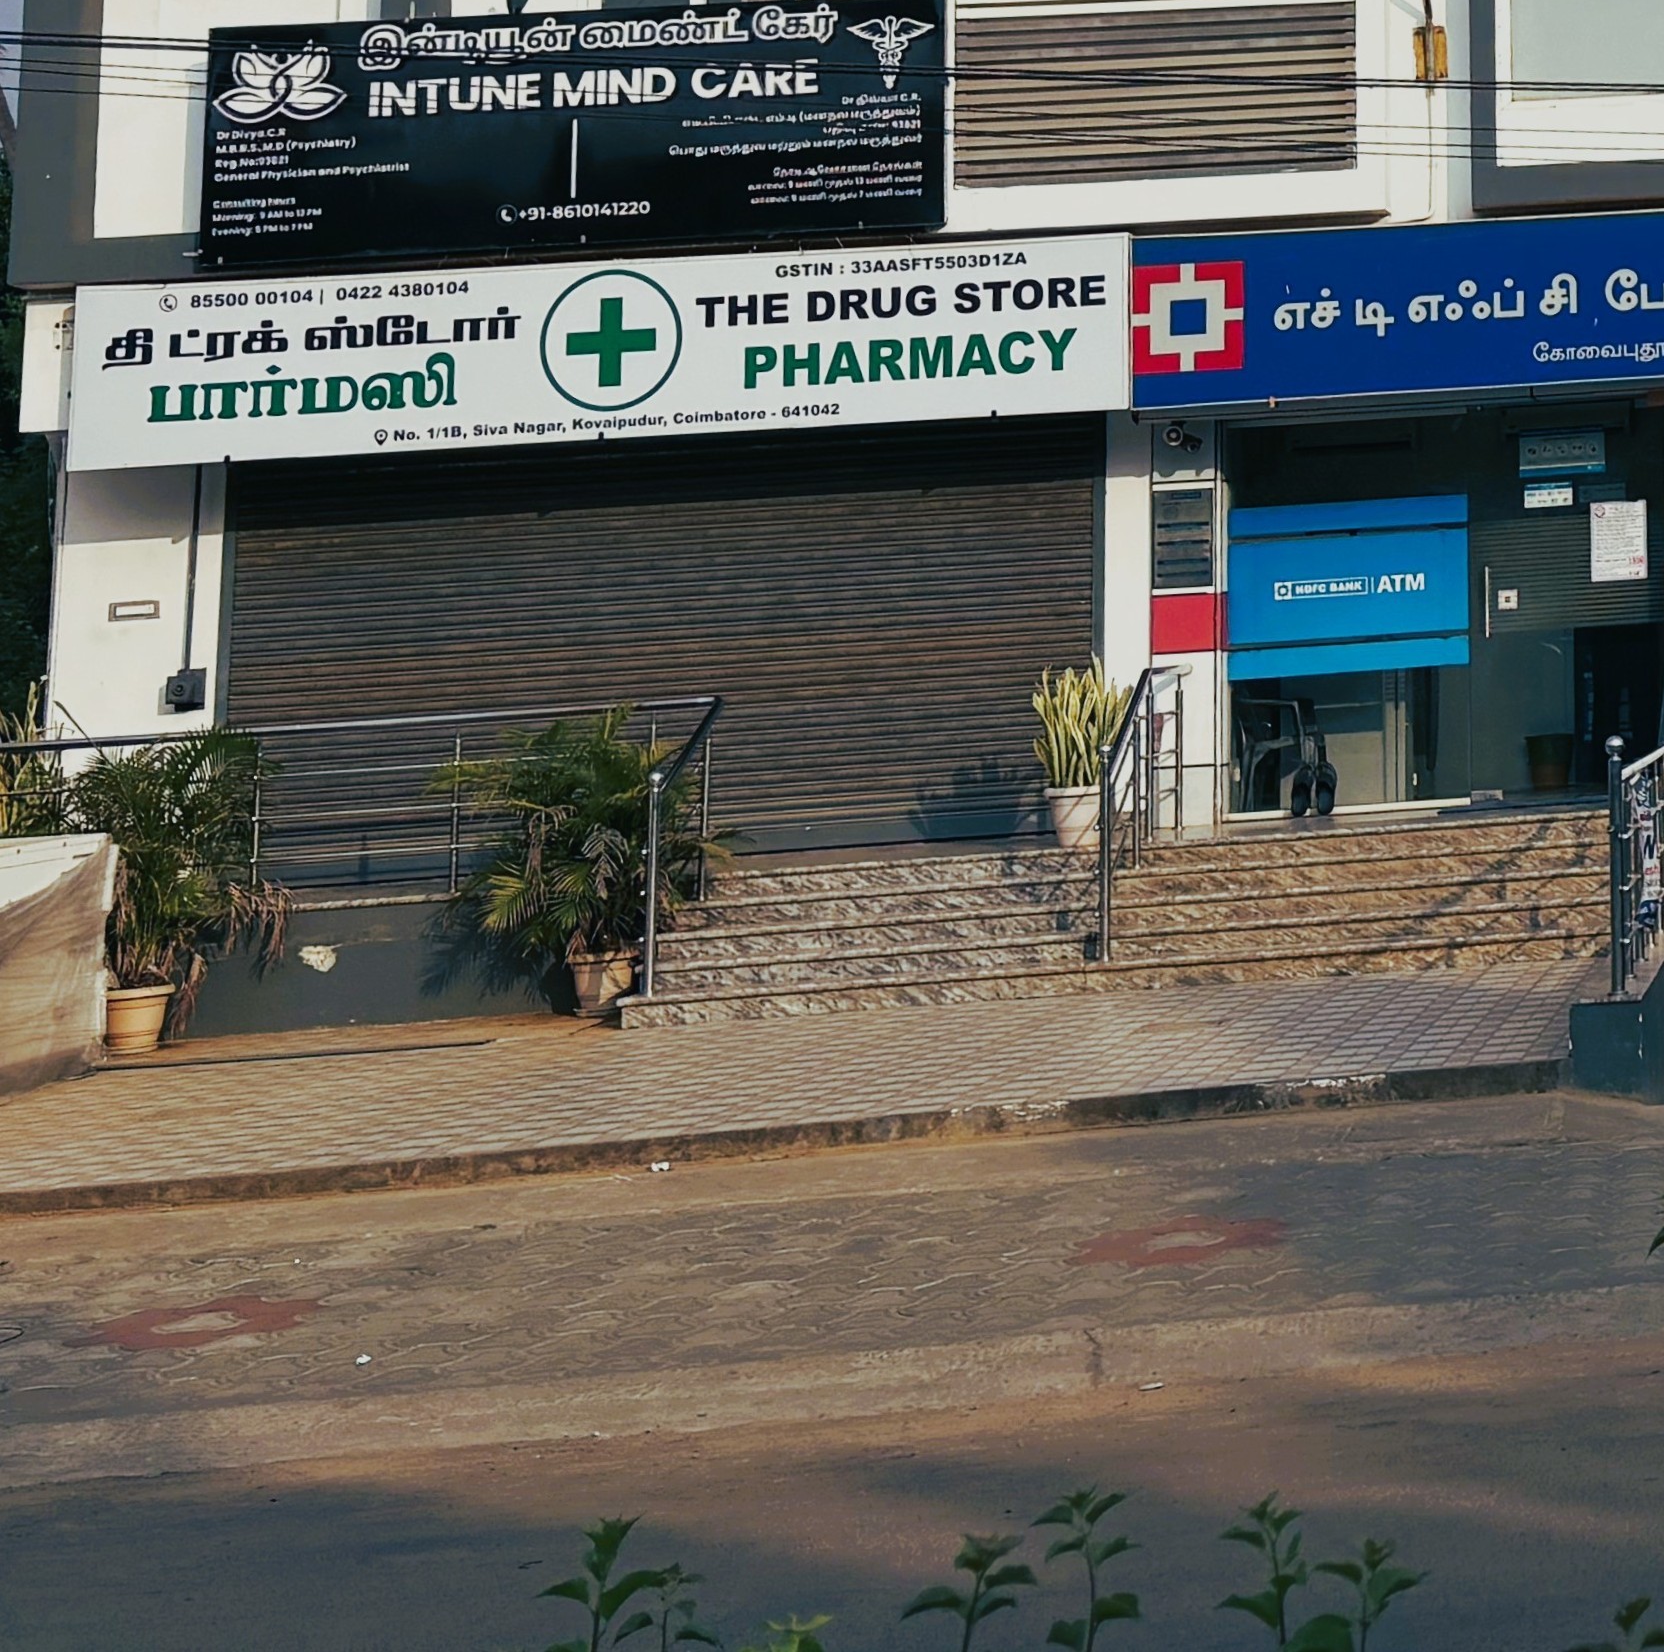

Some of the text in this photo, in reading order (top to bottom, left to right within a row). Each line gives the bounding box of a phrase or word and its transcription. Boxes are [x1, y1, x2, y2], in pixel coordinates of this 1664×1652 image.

[580, 8, 750, 50] மைண்ட்
[752, 3, 839, 45] கேர்
[367, 58, 820, 117] INTUNE MIND CARE
[216, 130, 230, 141] Dr
[214, 162, 410, 183] General Physician and Psychiatrist
[518, 200, 651, 222] +91-8610141220
[774, 260, 834, 279] GSTIN
[189, 279, 471, 310] 85500 00104 0422 4380104
[695, 274, 1108, 329] THE DRUG STORE
[1273, 286, 1341, 332] எச்
[1353, 295, 1396, 338] டி
[1406, 278, 1526, 323] எஃப்
[1537, 271, 1579, 316] சி
[100, 305, 523, 372] தி ட்ரக் ஸ்டோர்
[742, 326, 1079, 390] PHARMACY
[146, 351, 459, 424] பார்மஸி
[392, 402, 841, 444] No. 1/1B, Siva Nagar, Kovaipudur, Coimbatore 641042
[1294, 572, 1426, 595] HDFC BANK ATM
